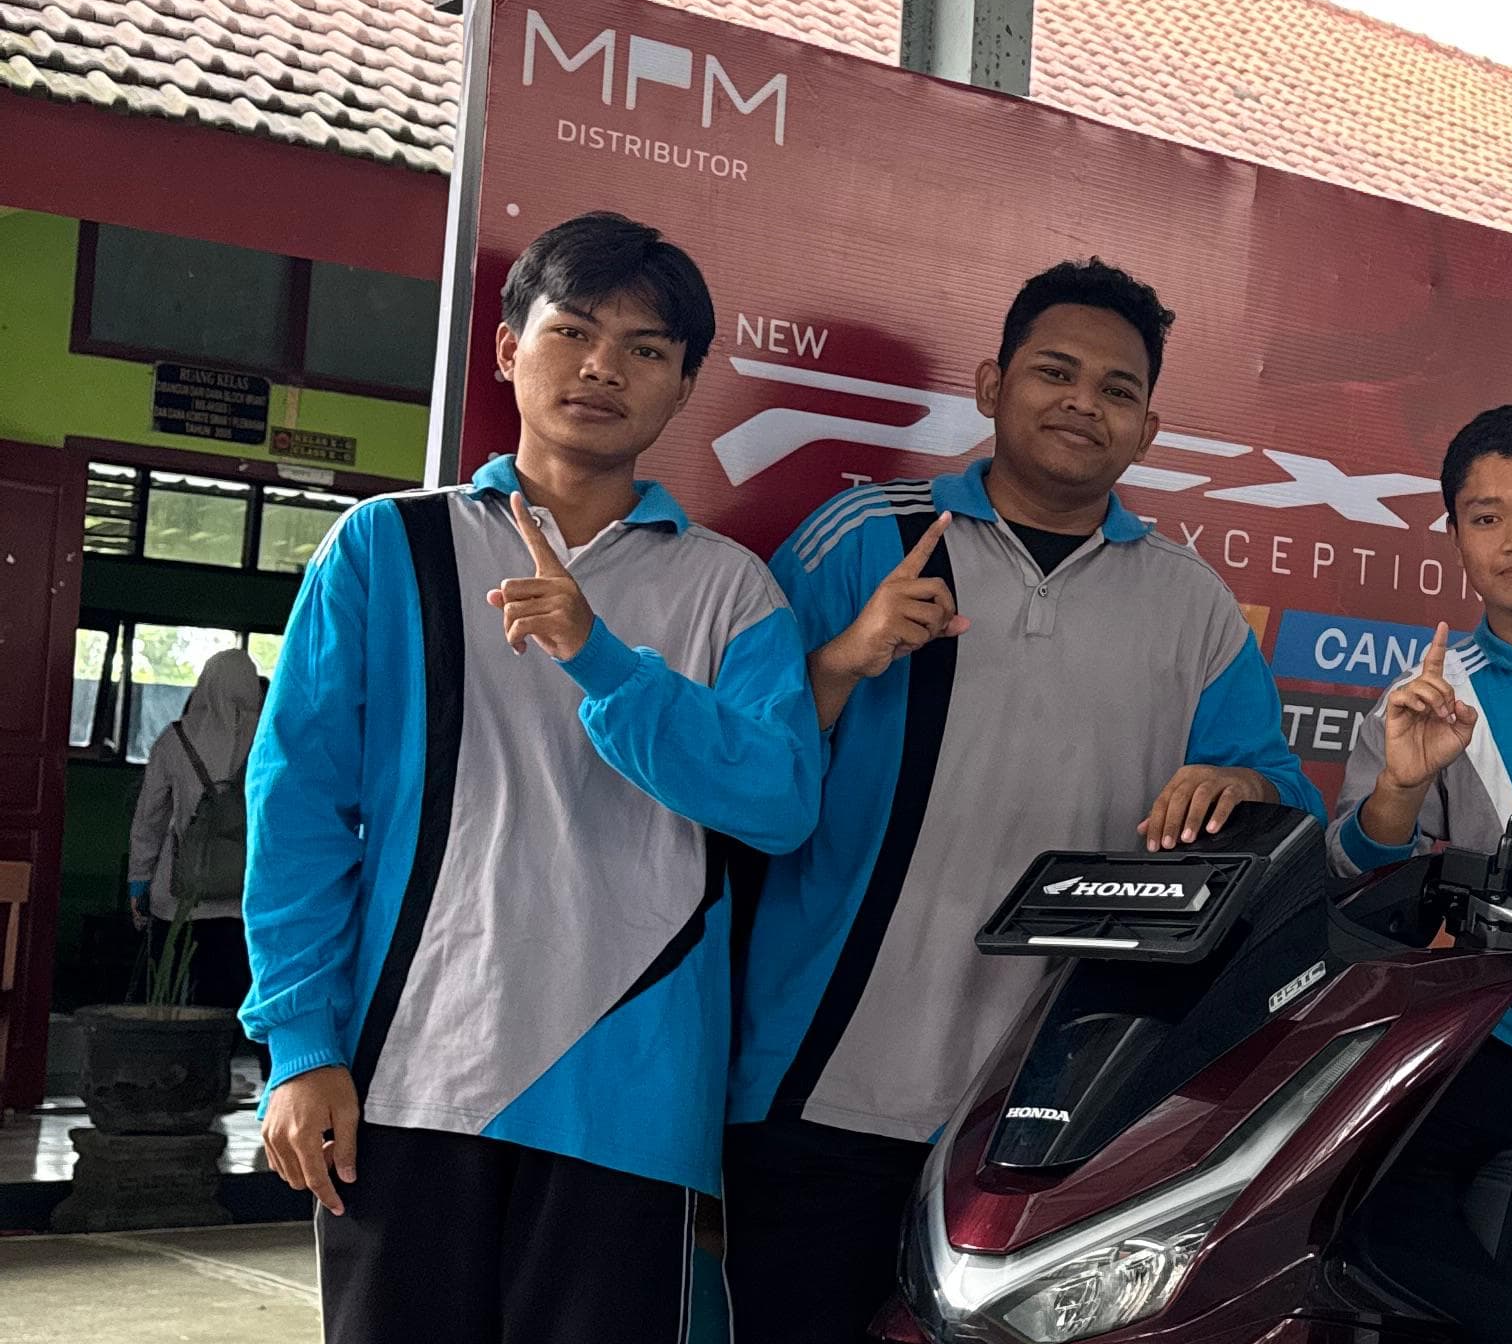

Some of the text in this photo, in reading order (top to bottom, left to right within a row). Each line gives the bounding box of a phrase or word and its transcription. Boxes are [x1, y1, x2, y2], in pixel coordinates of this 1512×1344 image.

[523, 8, 788, 146] MPM
[557, 119, 749, 181] DISTRIBUTOR
[735, 312, 829, 359] NEW
[1140, 516, 1483, 602] XCEPTIO
[1071, 882, 1185, 898] HONDA
[1006, 1107, 1071, 1123] HONDA
